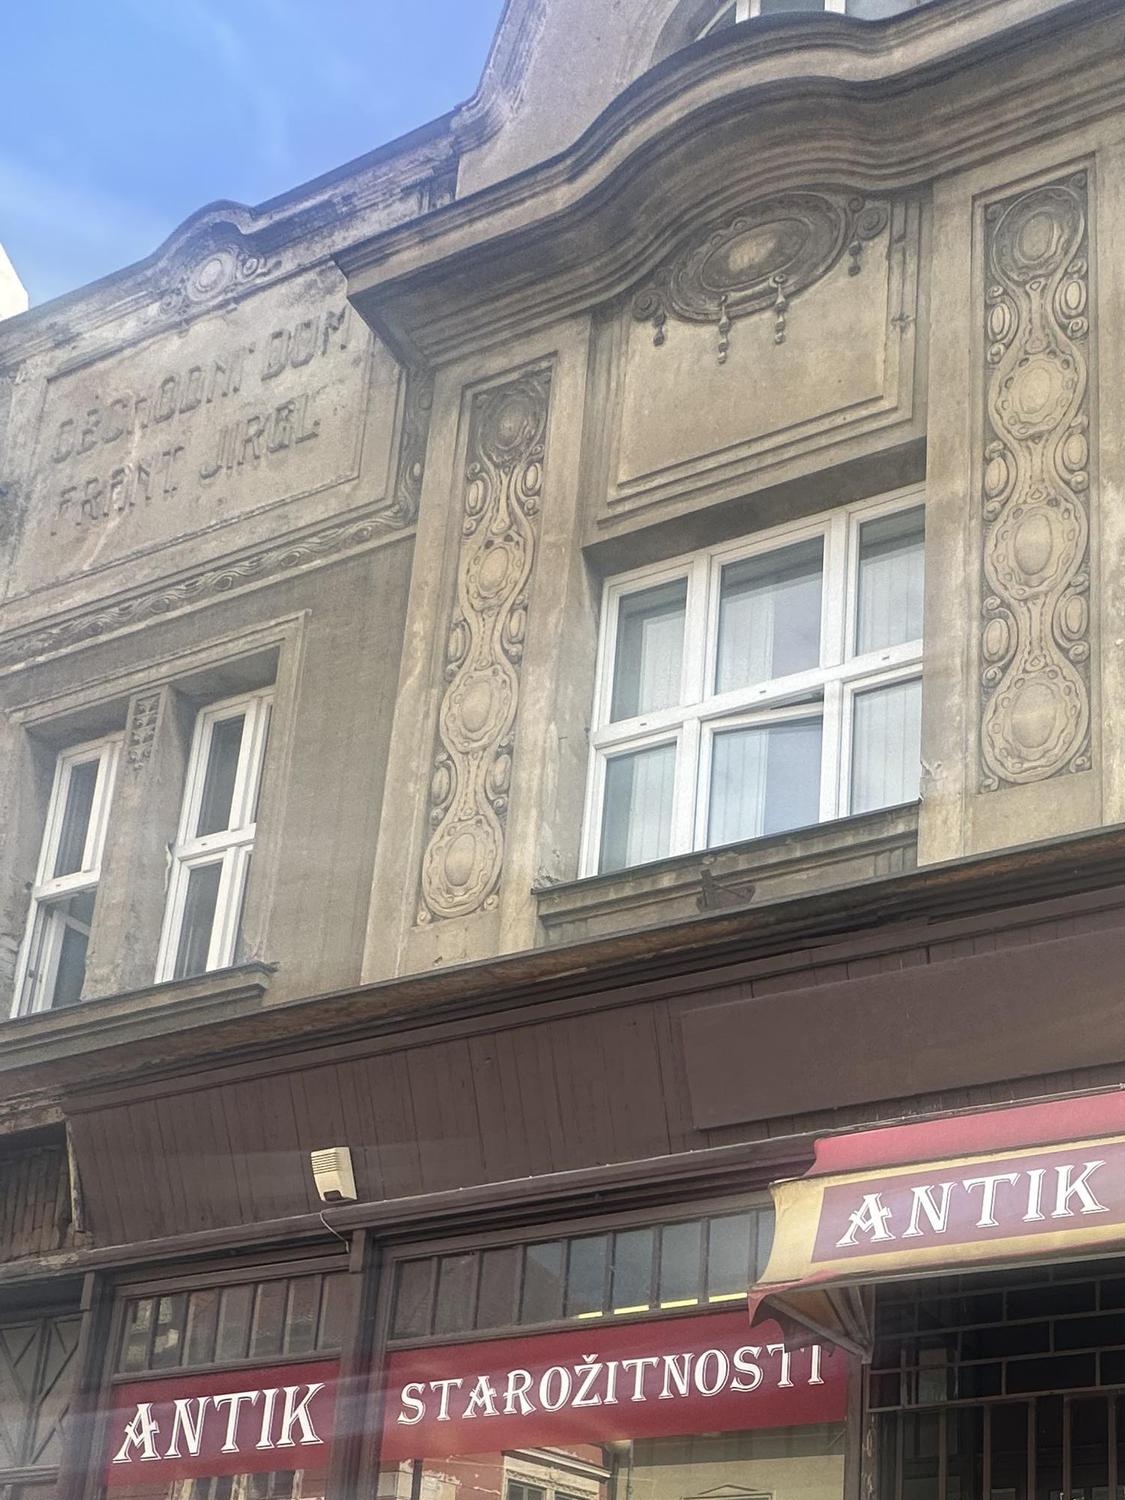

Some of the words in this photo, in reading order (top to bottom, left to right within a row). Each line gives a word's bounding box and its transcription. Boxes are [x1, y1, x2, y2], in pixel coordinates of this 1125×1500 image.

[836, 1160, 1109, 1247] ANTIK
[112, 1382, 326, 1464] ANTIK
[397, 1343, 824, 1425] STAROŽITNOSTI
